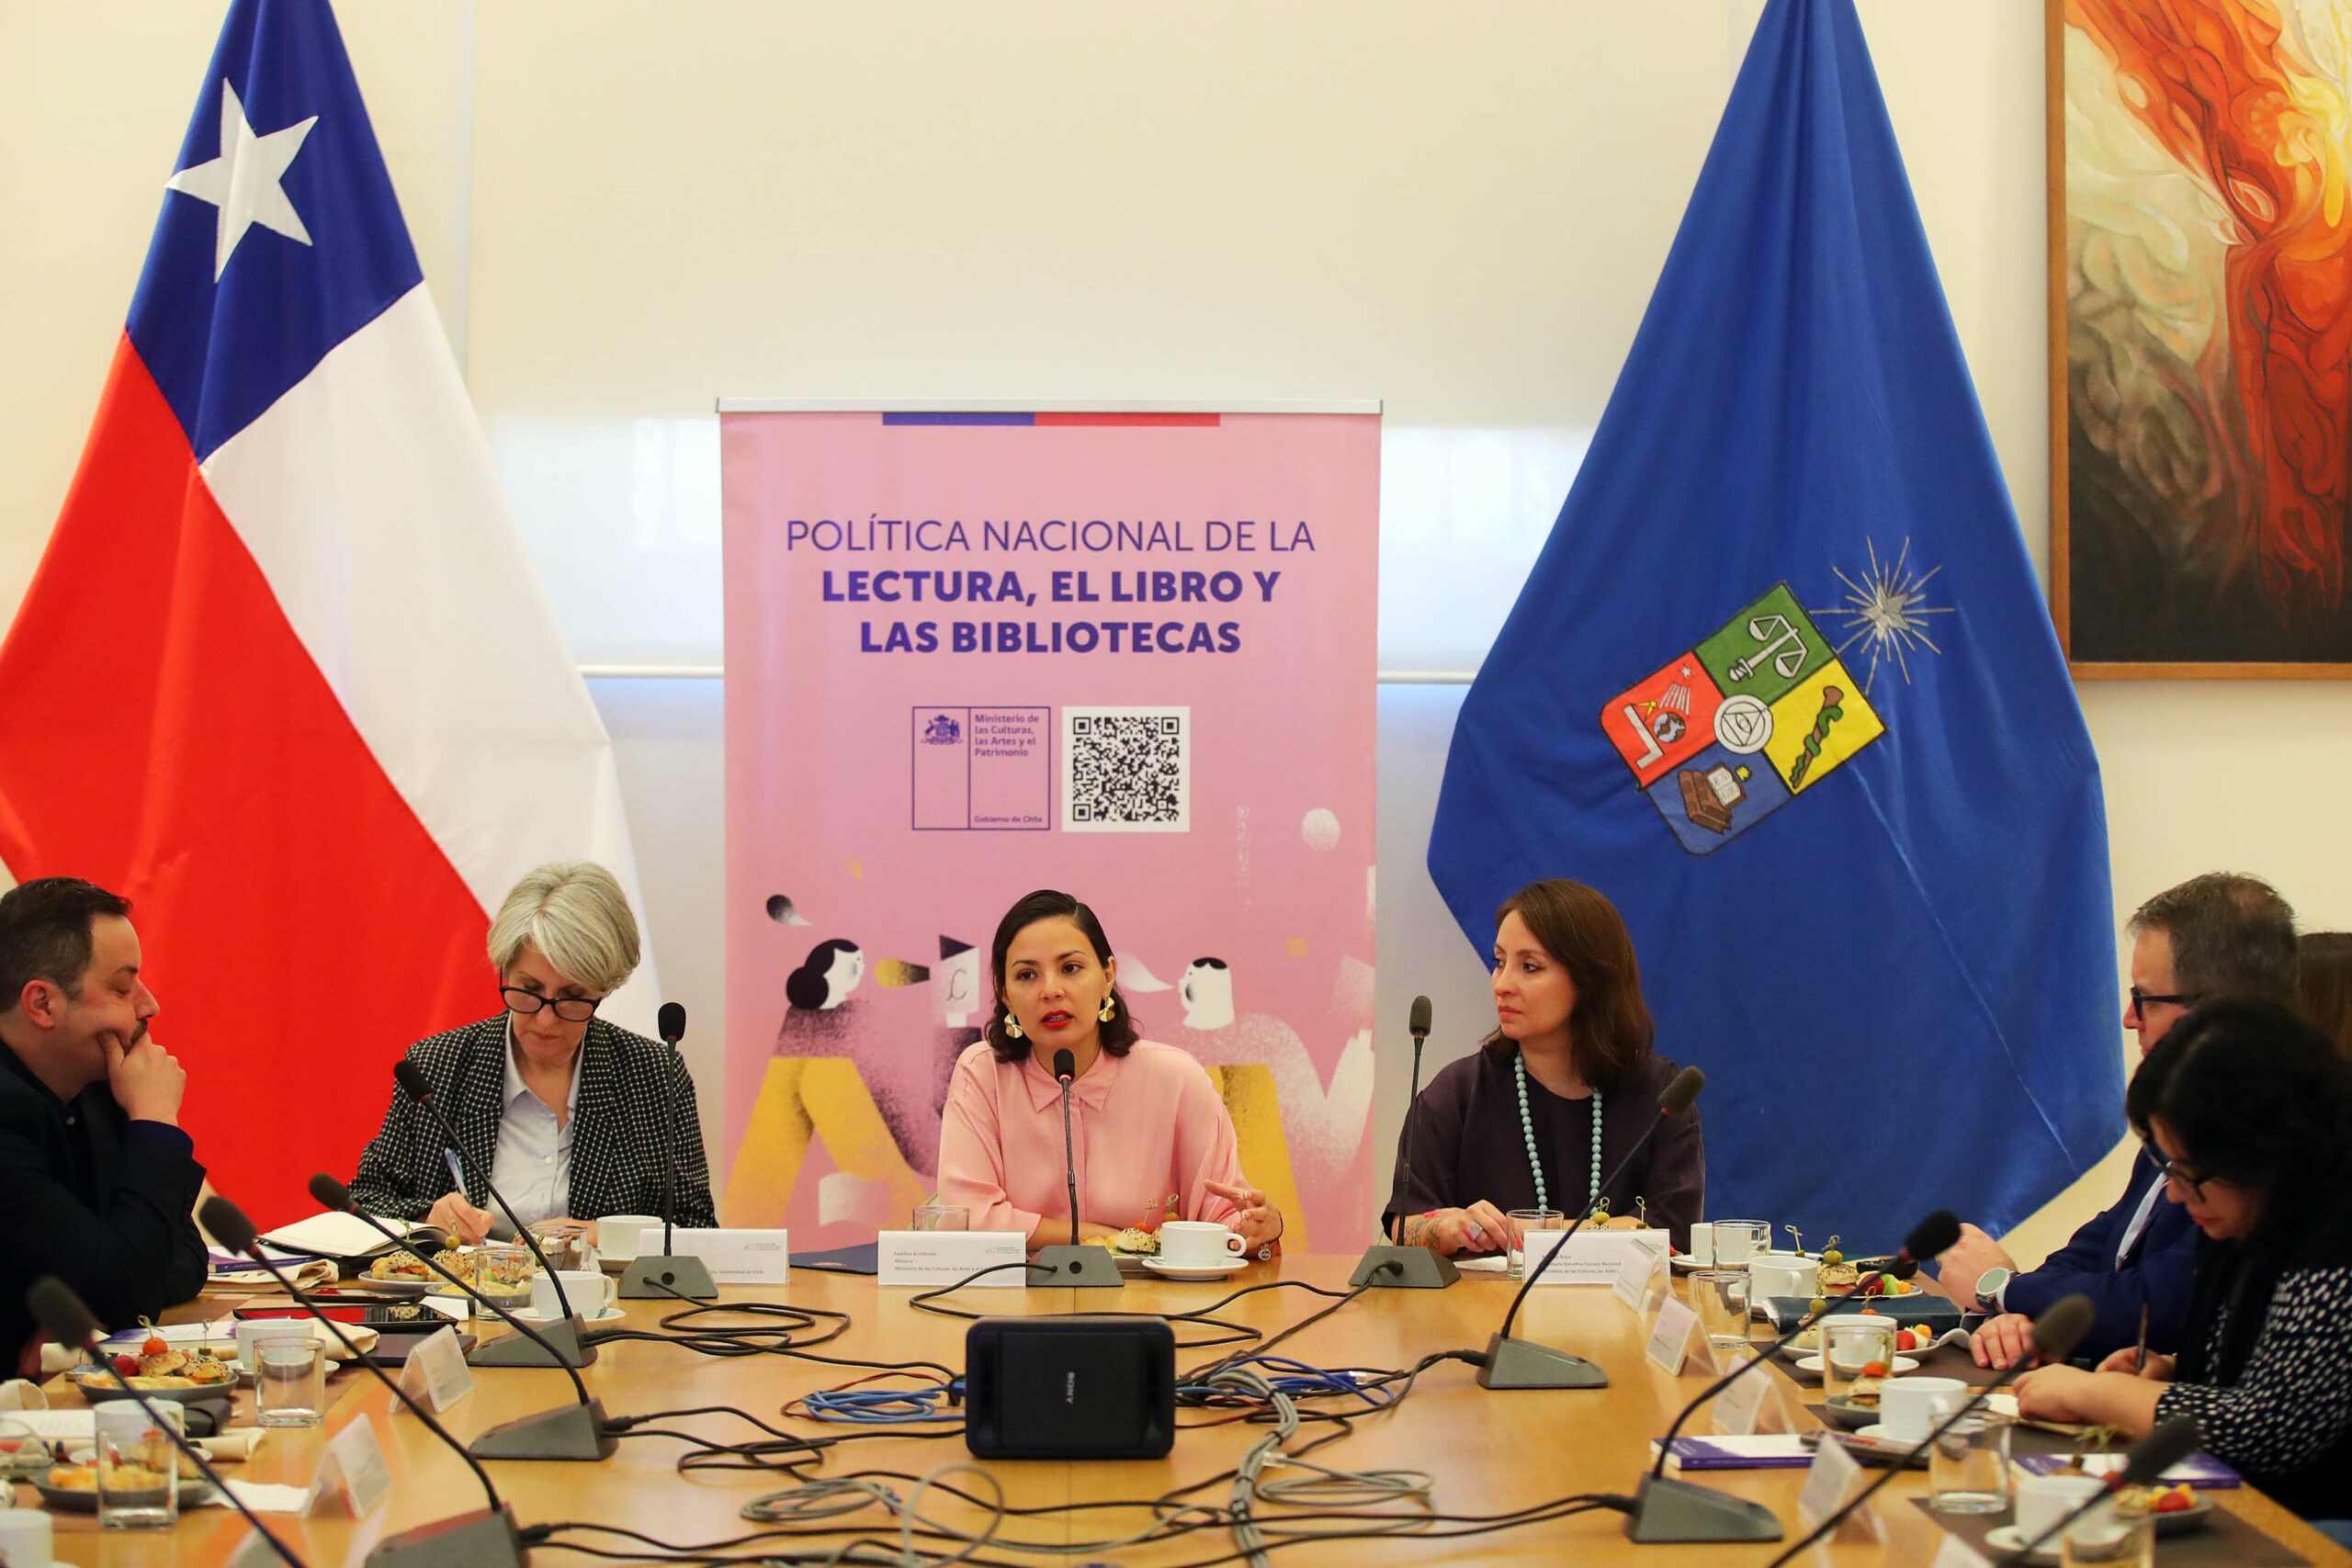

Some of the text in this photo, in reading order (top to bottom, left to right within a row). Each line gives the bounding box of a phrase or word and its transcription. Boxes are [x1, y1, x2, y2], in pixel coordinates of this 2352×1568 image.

[787, 513, 1316, 552] POLÍTICA NACIONAL DE LA
[823, 570, 1282, 607] LECTURA, EL LIBRO Y
[861, 622, 1241, 653] LAS BIBLIOTECAS
[975, 714, 1039, 723] Ministerio de
[975, 725, 1035, 736] las Culturas,
[975, 736, 1036, 747] las Artes y el
[975, 748, 1029, 757] Patrimonio
[974, 816, 1043, 824] Gobierno de Chile
